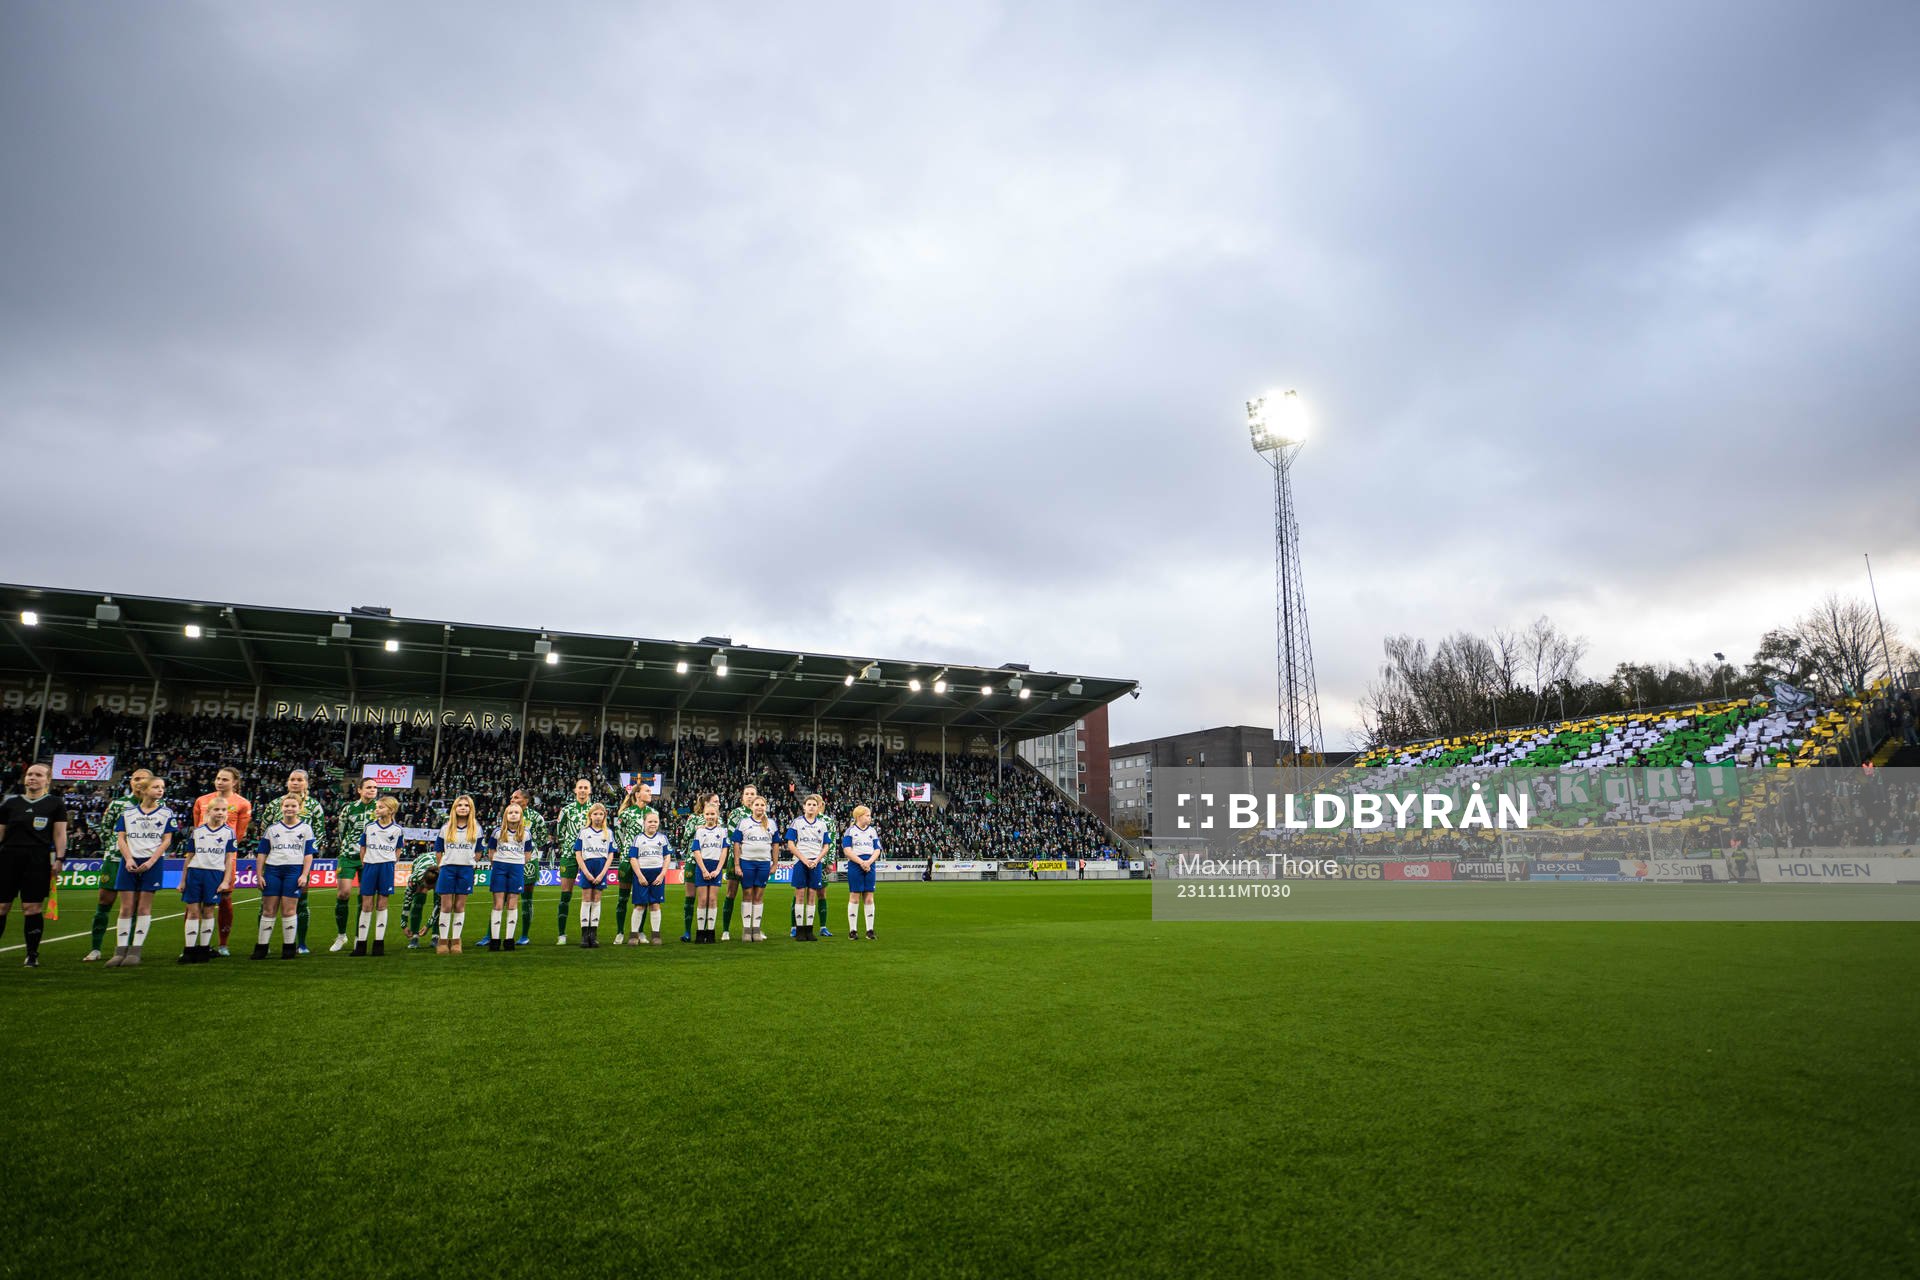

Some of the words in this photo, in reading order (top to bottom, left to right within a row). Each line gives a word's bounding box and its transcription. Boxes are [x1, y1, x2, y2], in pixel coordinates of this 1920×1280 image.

[3, 690, 68, 711] 948
[94, 694, 168, 714] 1952
[529, 717, 582, 735] 1957
[70, 760, 91, 769] ICA
[377, 769, 395, 778] ICA
[272, 843, 303, 851] HOLMEN
[1671, 862, 1702, 876] Smit
[1778, 863, 1871, 877] HOLMEN
